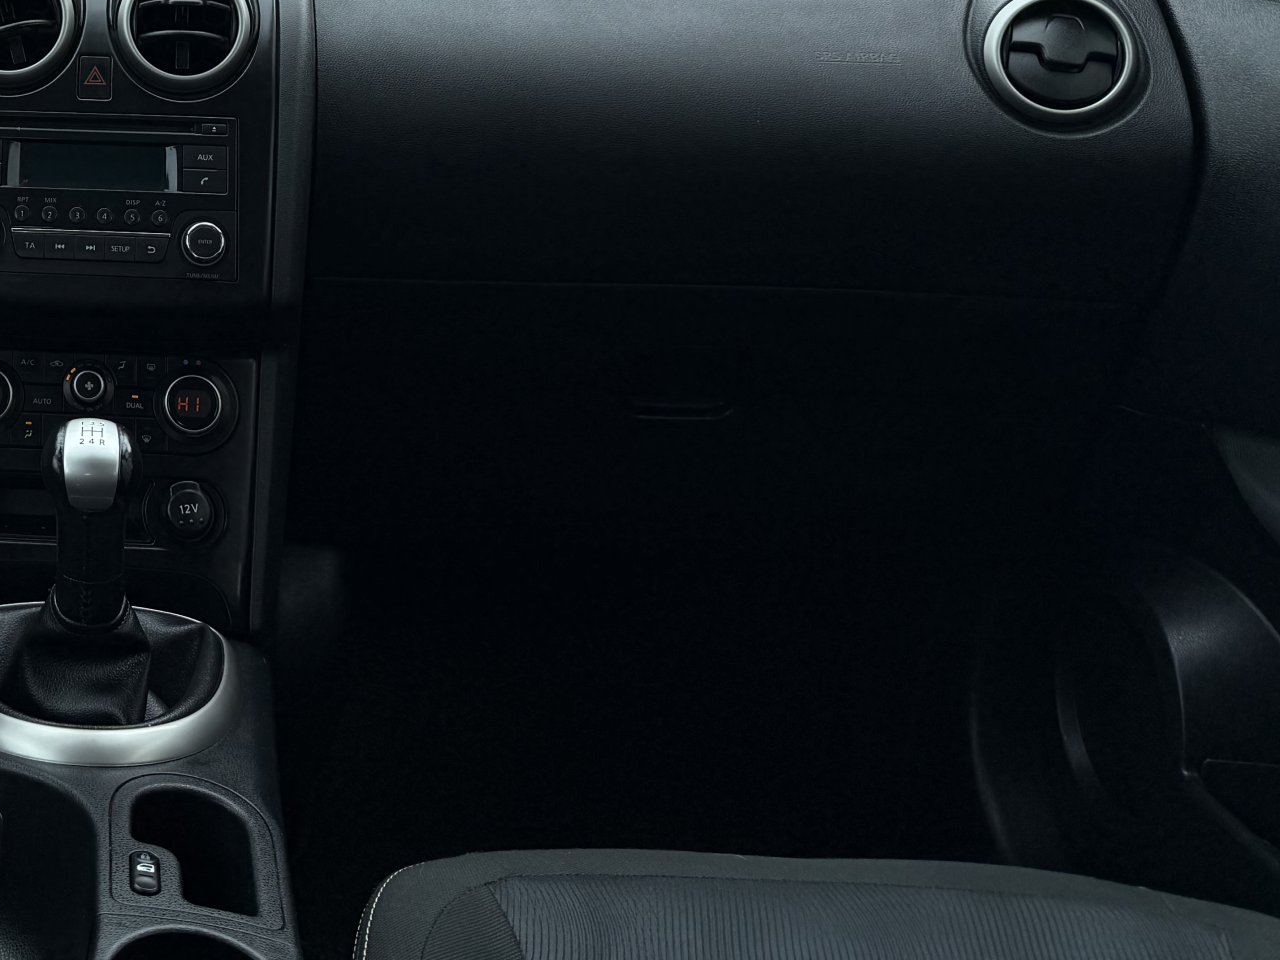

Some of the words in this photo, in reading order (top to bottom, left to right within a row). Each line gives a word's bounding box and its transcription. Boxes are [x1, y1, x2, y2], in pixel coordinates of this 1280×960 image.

[197, 153, 214, 162] AUX
[44, 196, 57, 204] MIX
[110, 244, 131, 253] SETUP
[20, 358, 35, 367] A/C
[32, 397, 52, 405] AUTO
[178, 503, 199, 515] 12V
